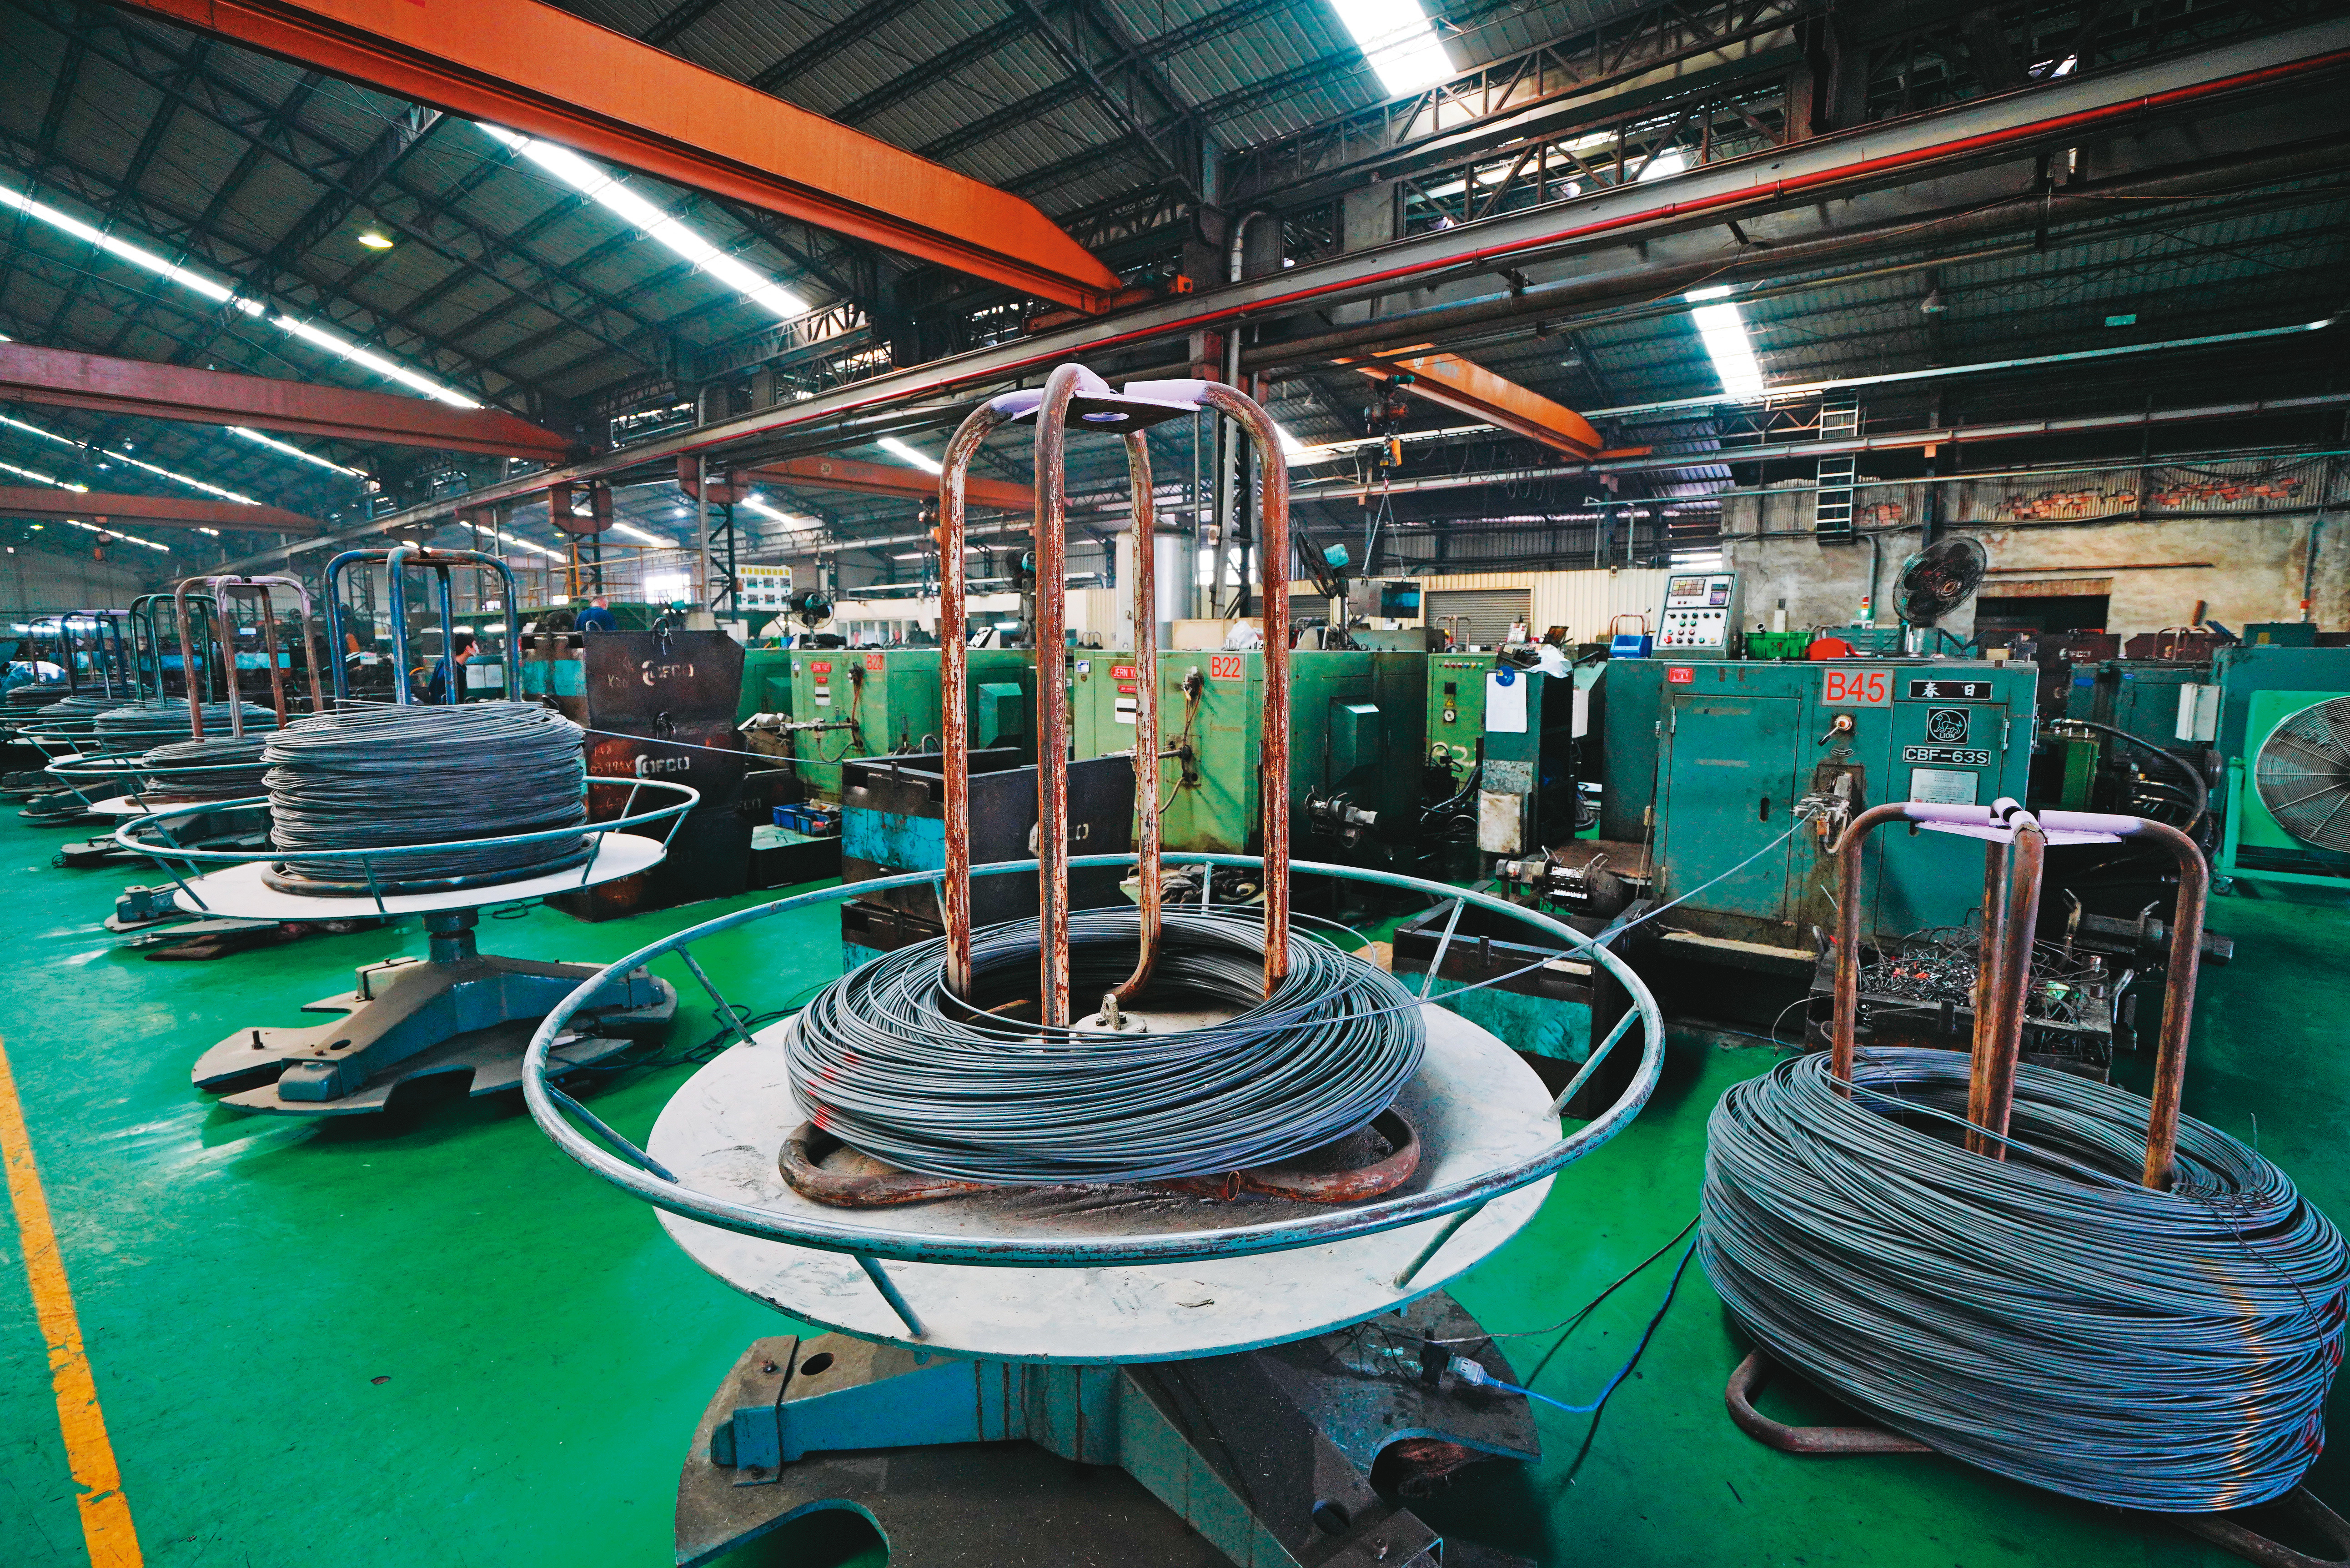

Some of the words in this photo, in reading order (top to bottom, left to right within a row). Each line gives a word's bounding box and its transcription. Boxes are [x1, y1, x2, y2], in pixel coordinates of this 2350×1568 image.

[866, 655, 884, 670] B23
[1212, 657, 1240, 678] B22
[1827, 672, 1885, 702] B45
[1922, 683, 1976, 698] 春日
[1905, 749, 1988, 764] CBF-63S
